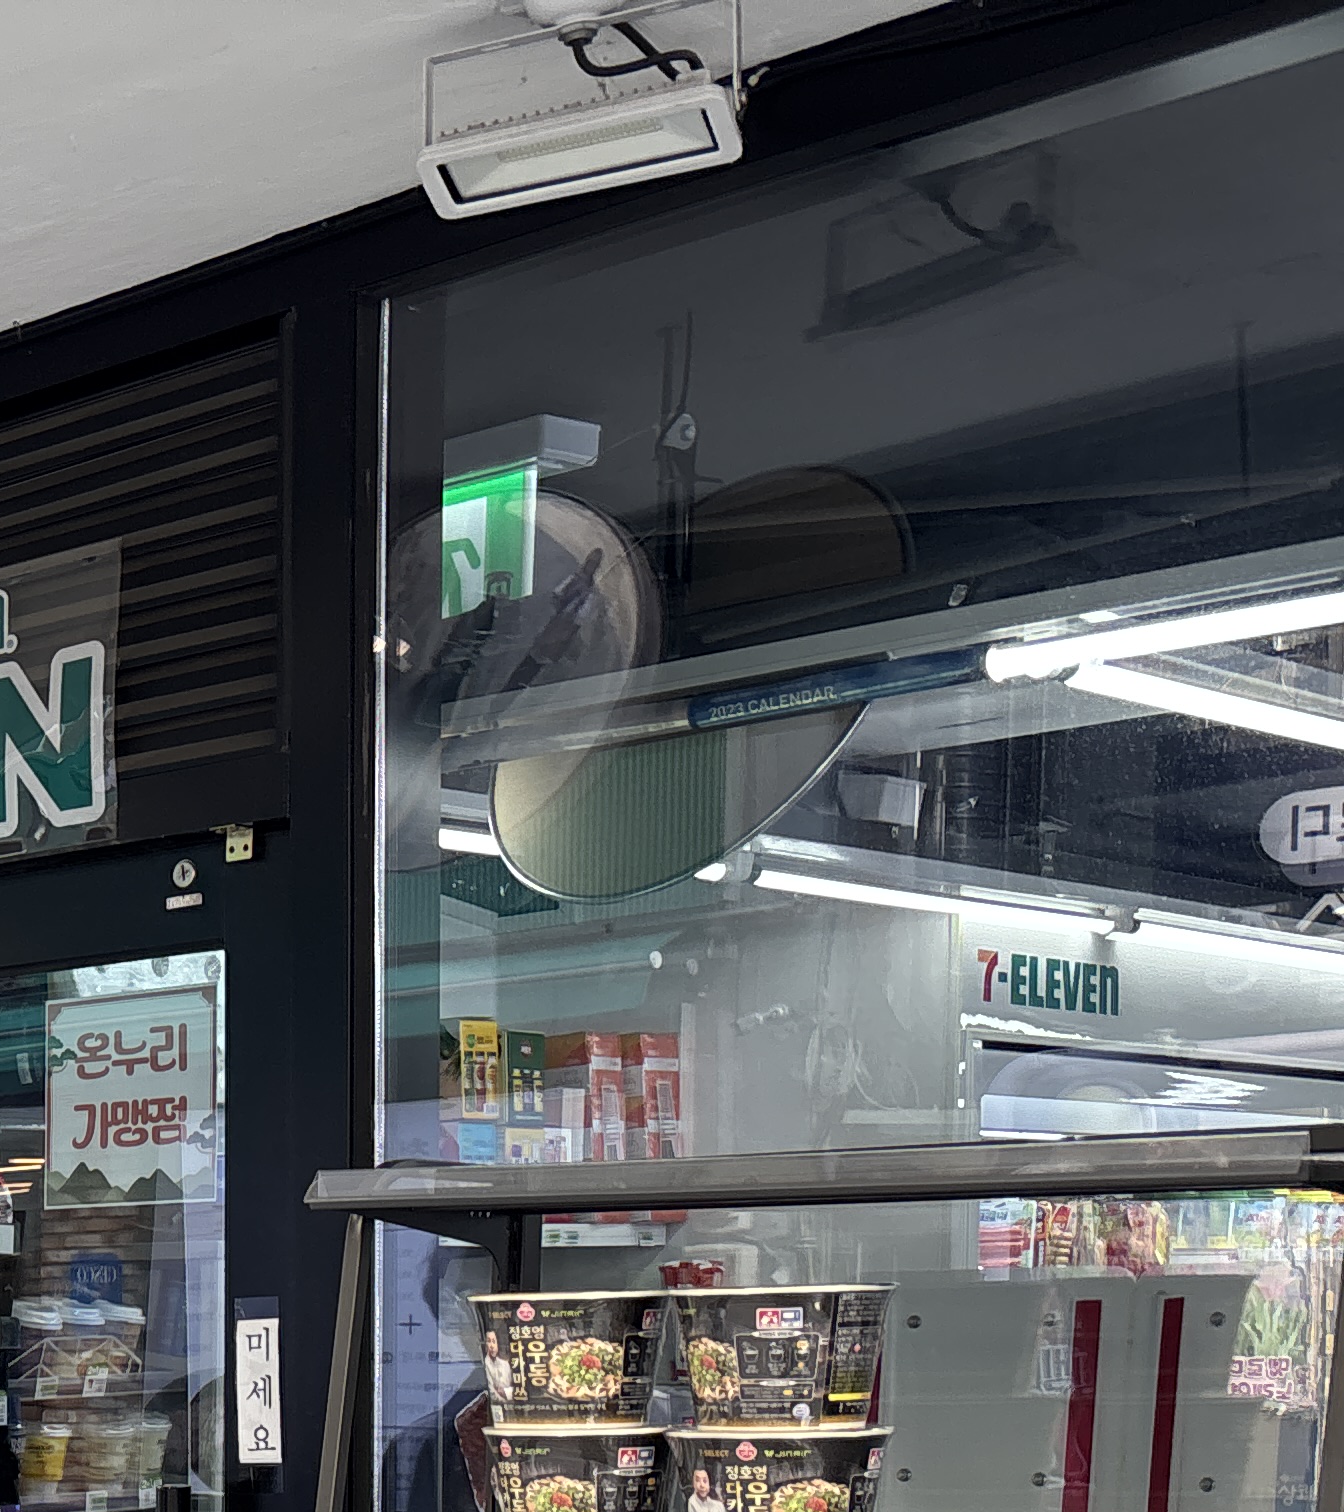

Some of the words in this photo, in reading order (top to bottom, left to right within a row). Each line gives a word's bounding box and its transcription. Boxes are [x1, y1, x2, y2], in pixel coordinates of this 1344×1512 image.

[748, 685, 839, 719] CALENDAR
[976, 948, 1121, 1018] 7-ELEVEN
[74, 1022, 190, 1080] 온누리
[71, 1095, 190, 1150] 가맹점
[247, 1325, 277, 1452] 미세요
[526, 1341, 549, 1387] 우동
